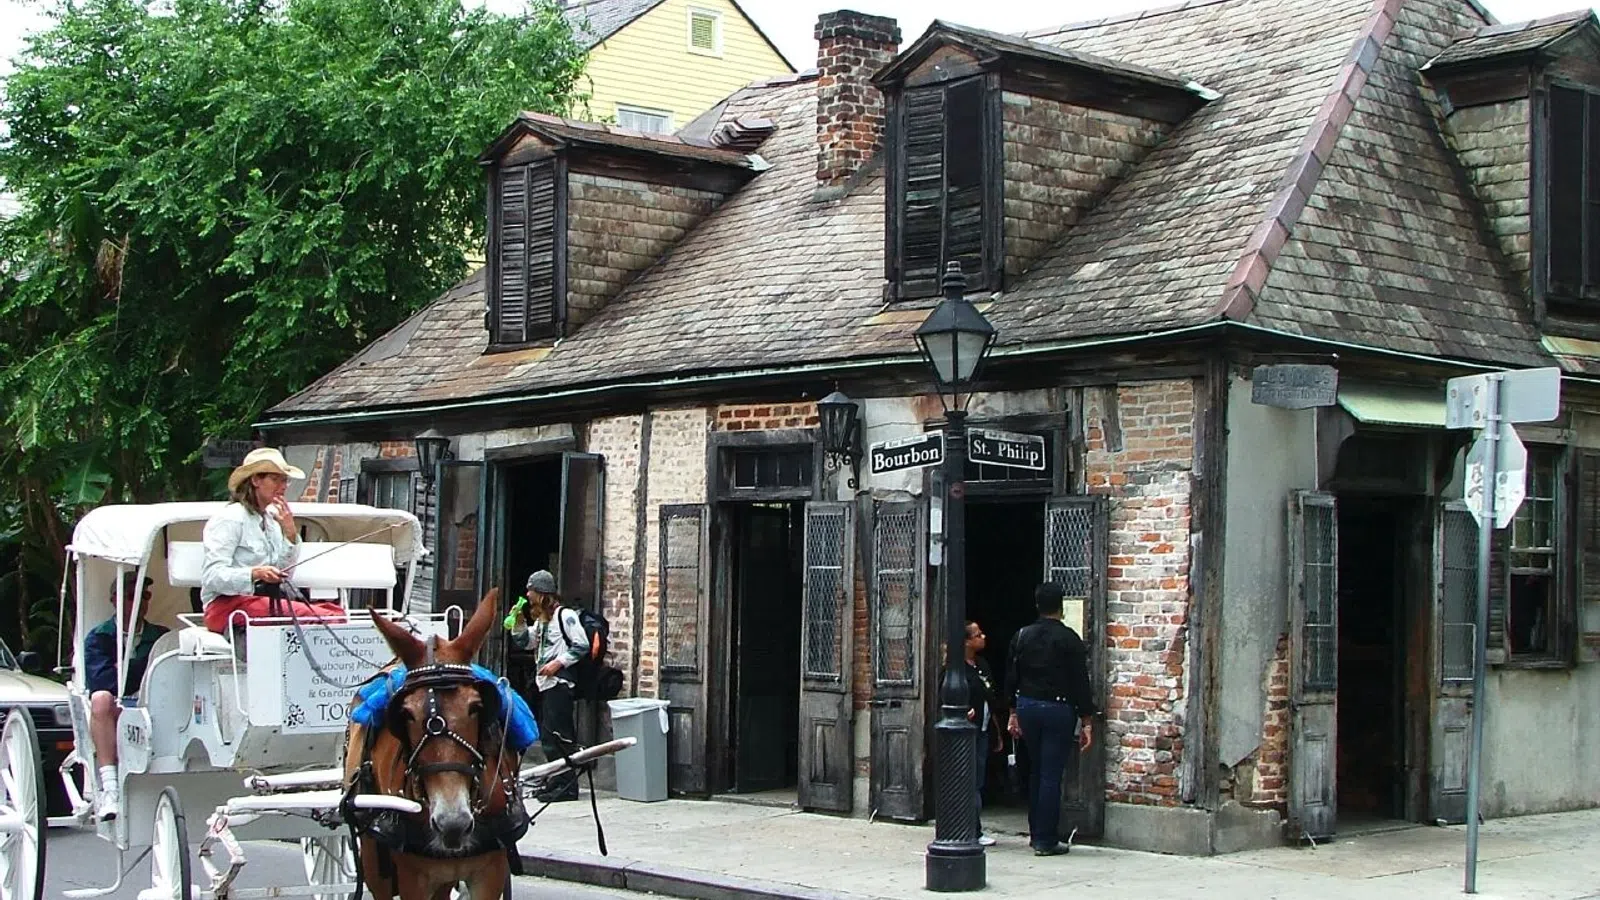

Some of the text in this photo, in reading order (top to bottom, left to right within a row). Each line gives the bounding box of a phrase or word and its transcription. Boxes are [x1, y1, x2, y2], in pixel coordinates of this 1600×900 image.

[873, 446, 940, 471] Bourbon
[972, 439, 1040, 467] St. Philip
[313, 635, 385, 645] French Quarte
